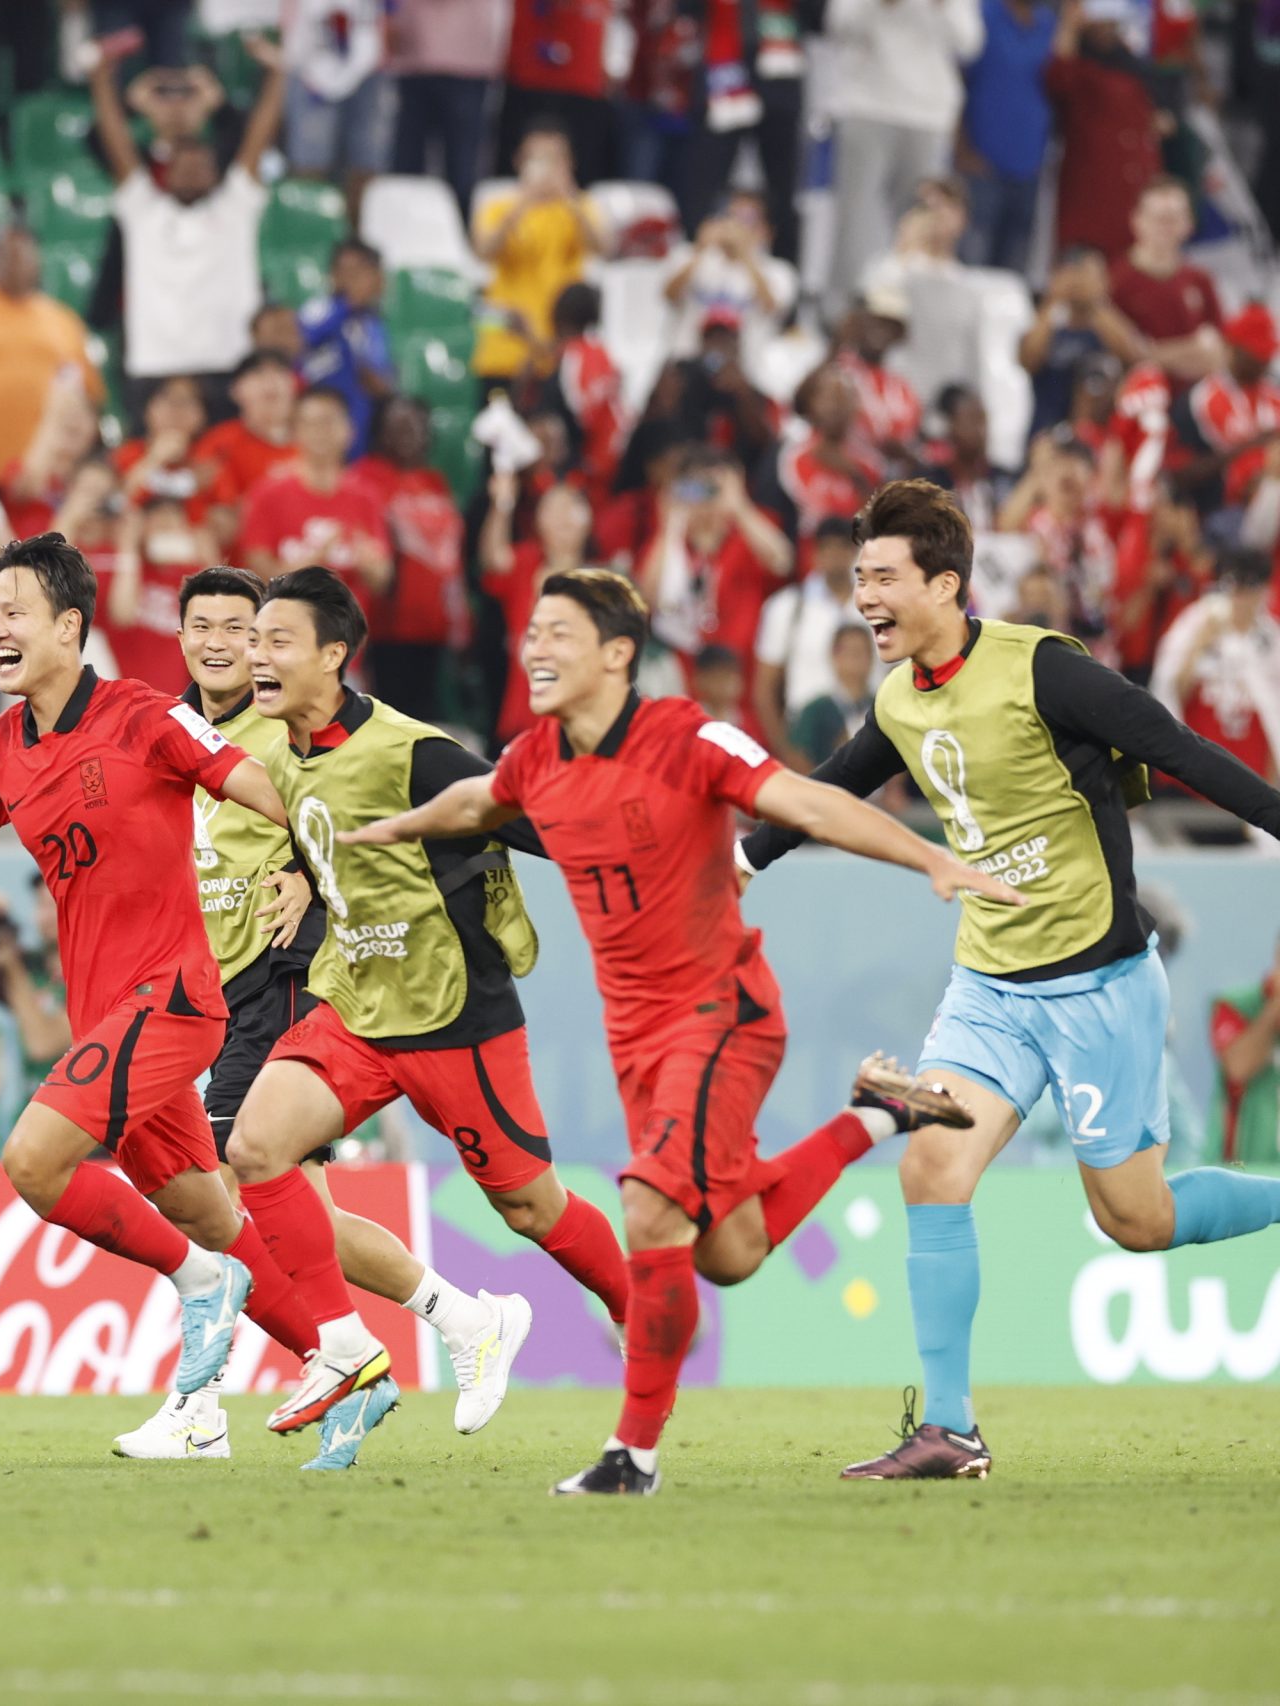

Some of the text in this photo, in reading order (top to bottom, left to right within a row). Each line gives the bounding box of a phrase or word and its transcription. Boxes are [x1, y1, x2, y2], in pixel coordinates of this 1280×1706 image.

[41, 821, 97, 880] 20
[1011, 836, 1048, 862] CUP
[374, 921, 409, 939] CUP
[454, 1126, 489, 1168] 8
